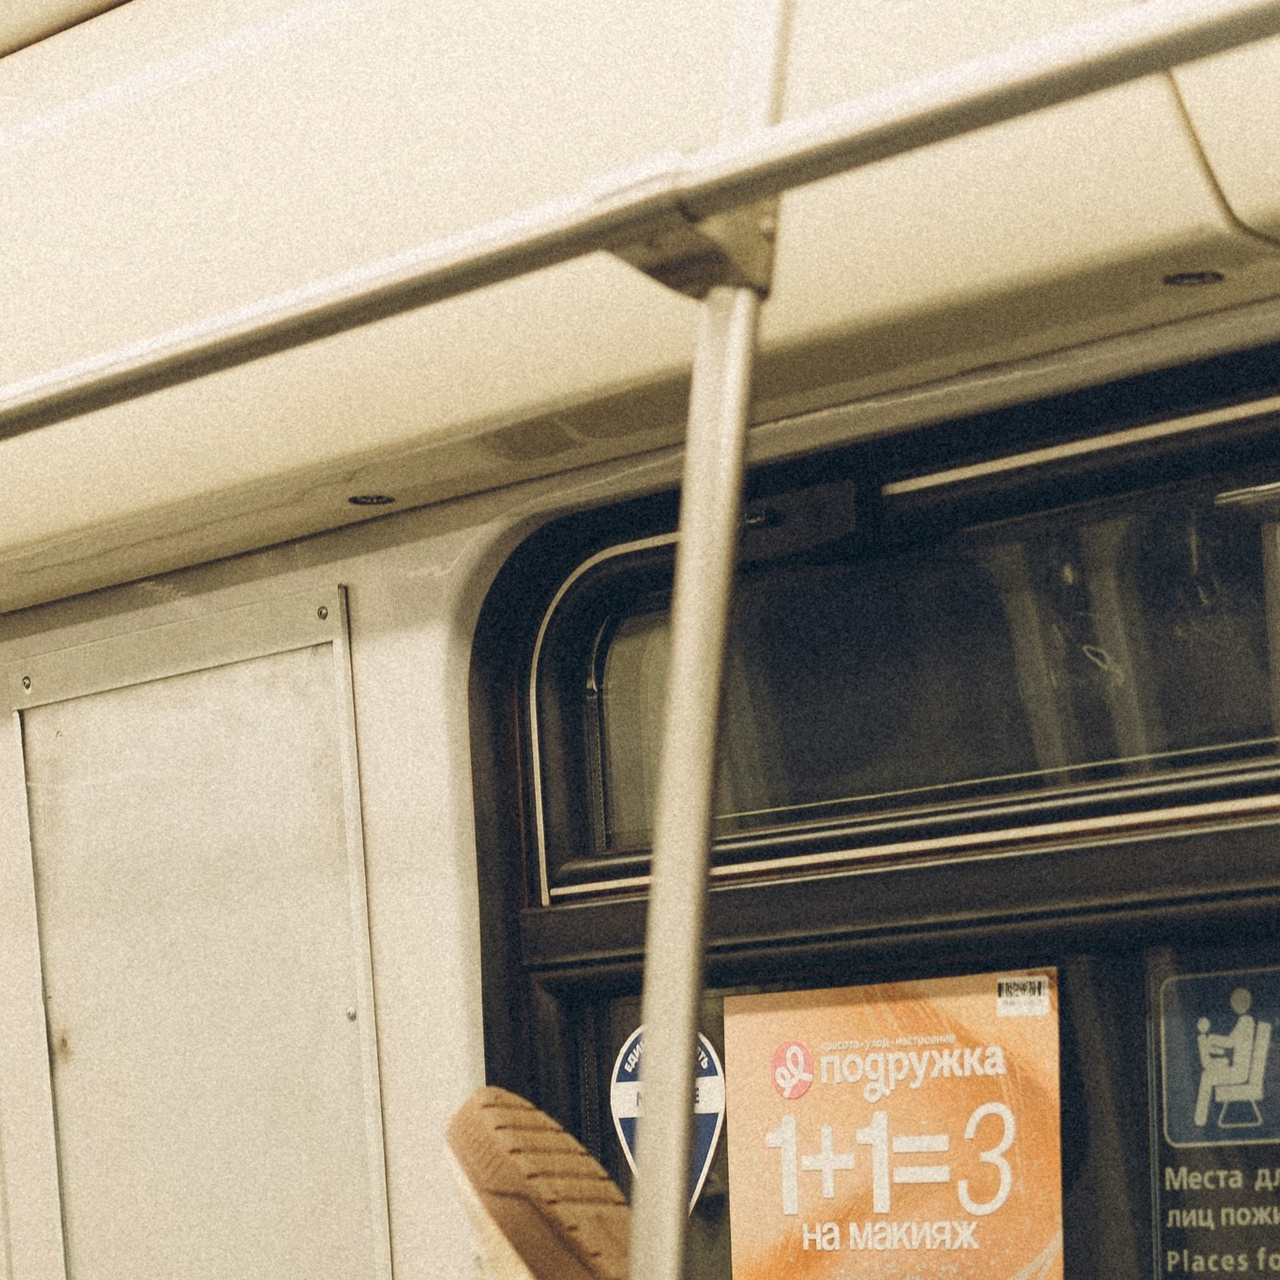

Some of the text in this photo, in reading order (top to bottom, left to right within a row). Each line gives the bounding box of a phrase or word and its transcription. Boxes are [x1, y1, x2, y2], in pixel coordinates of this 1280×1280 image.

[821, 1045, 1007, 1104] подружка
[765, 1102, 1017, 1216] 1+1=3
[1164, 1166, 1243, 1191] Места
[1167, 1208, 1216, 1231] лиц
[802, 1220, 980, 1251] на макияж
[1167, 1248, 1249, 1272] Places
